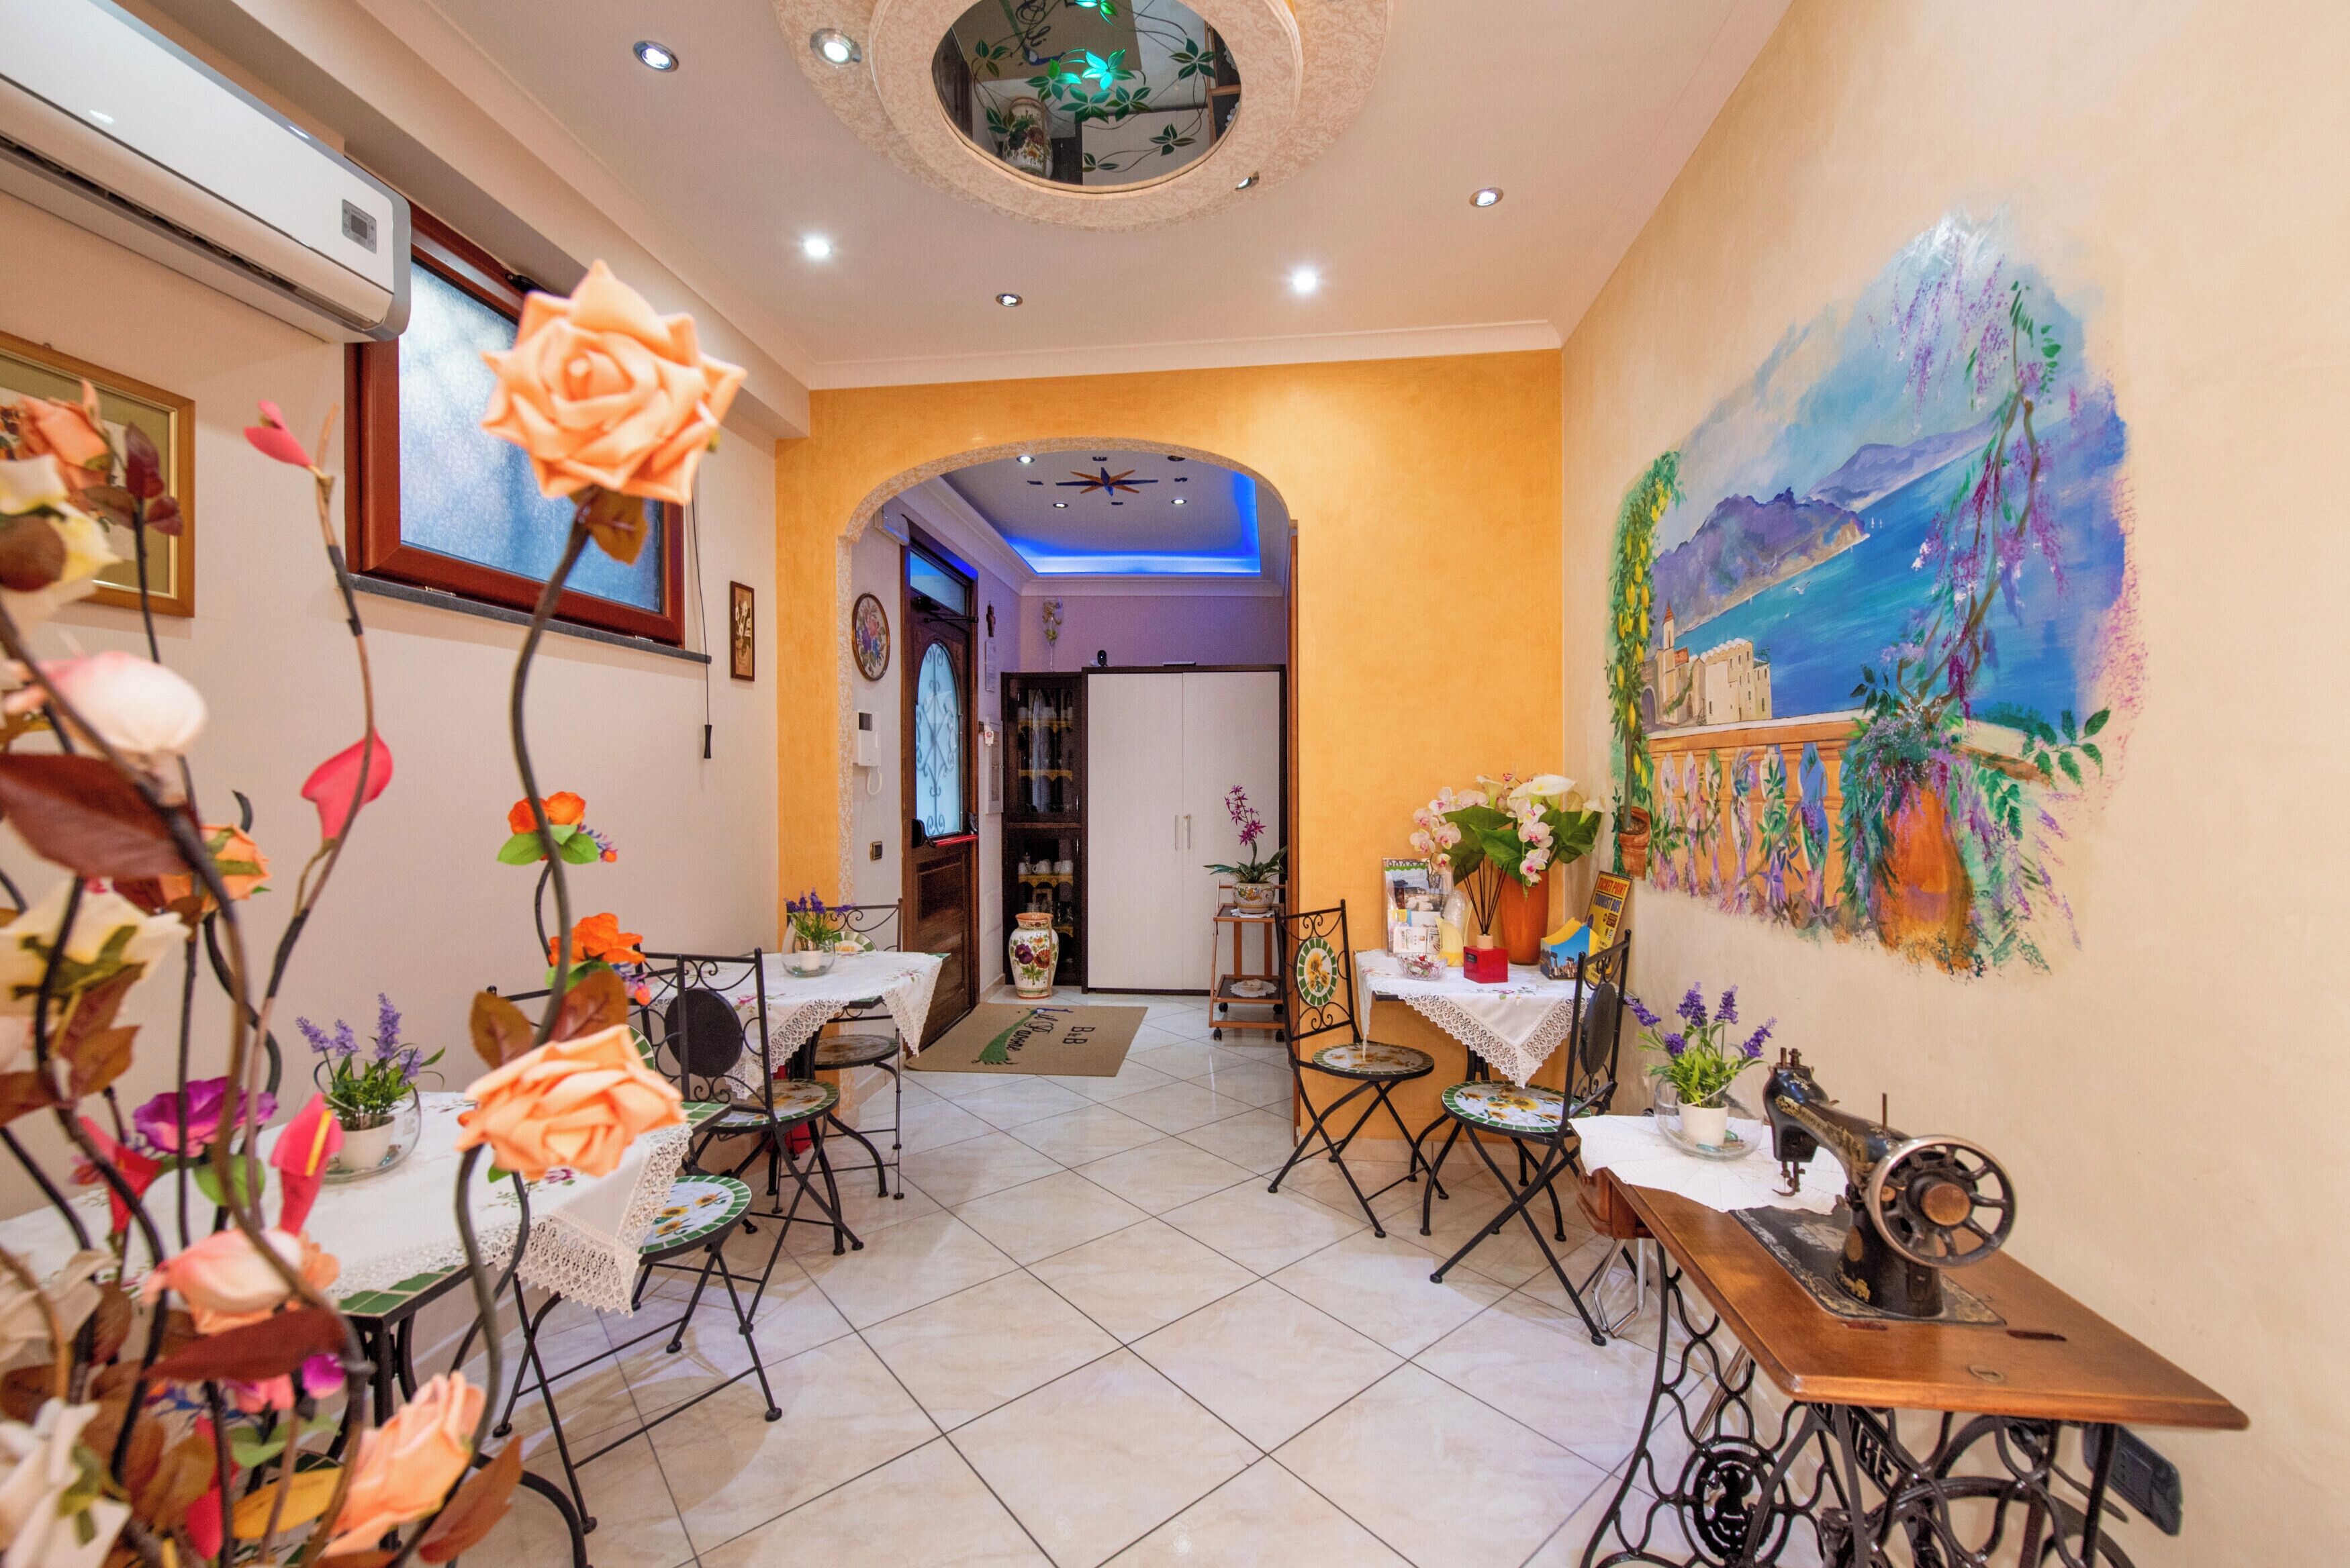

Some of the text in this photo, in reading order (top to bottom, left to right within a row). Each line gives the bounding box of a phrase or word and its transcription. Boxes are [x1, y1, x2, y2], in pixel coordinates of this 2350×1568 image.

[1599, 878, 1628, 897] TICKET POINT
[1594, 893, 1622, 913] TOURIST BUS
